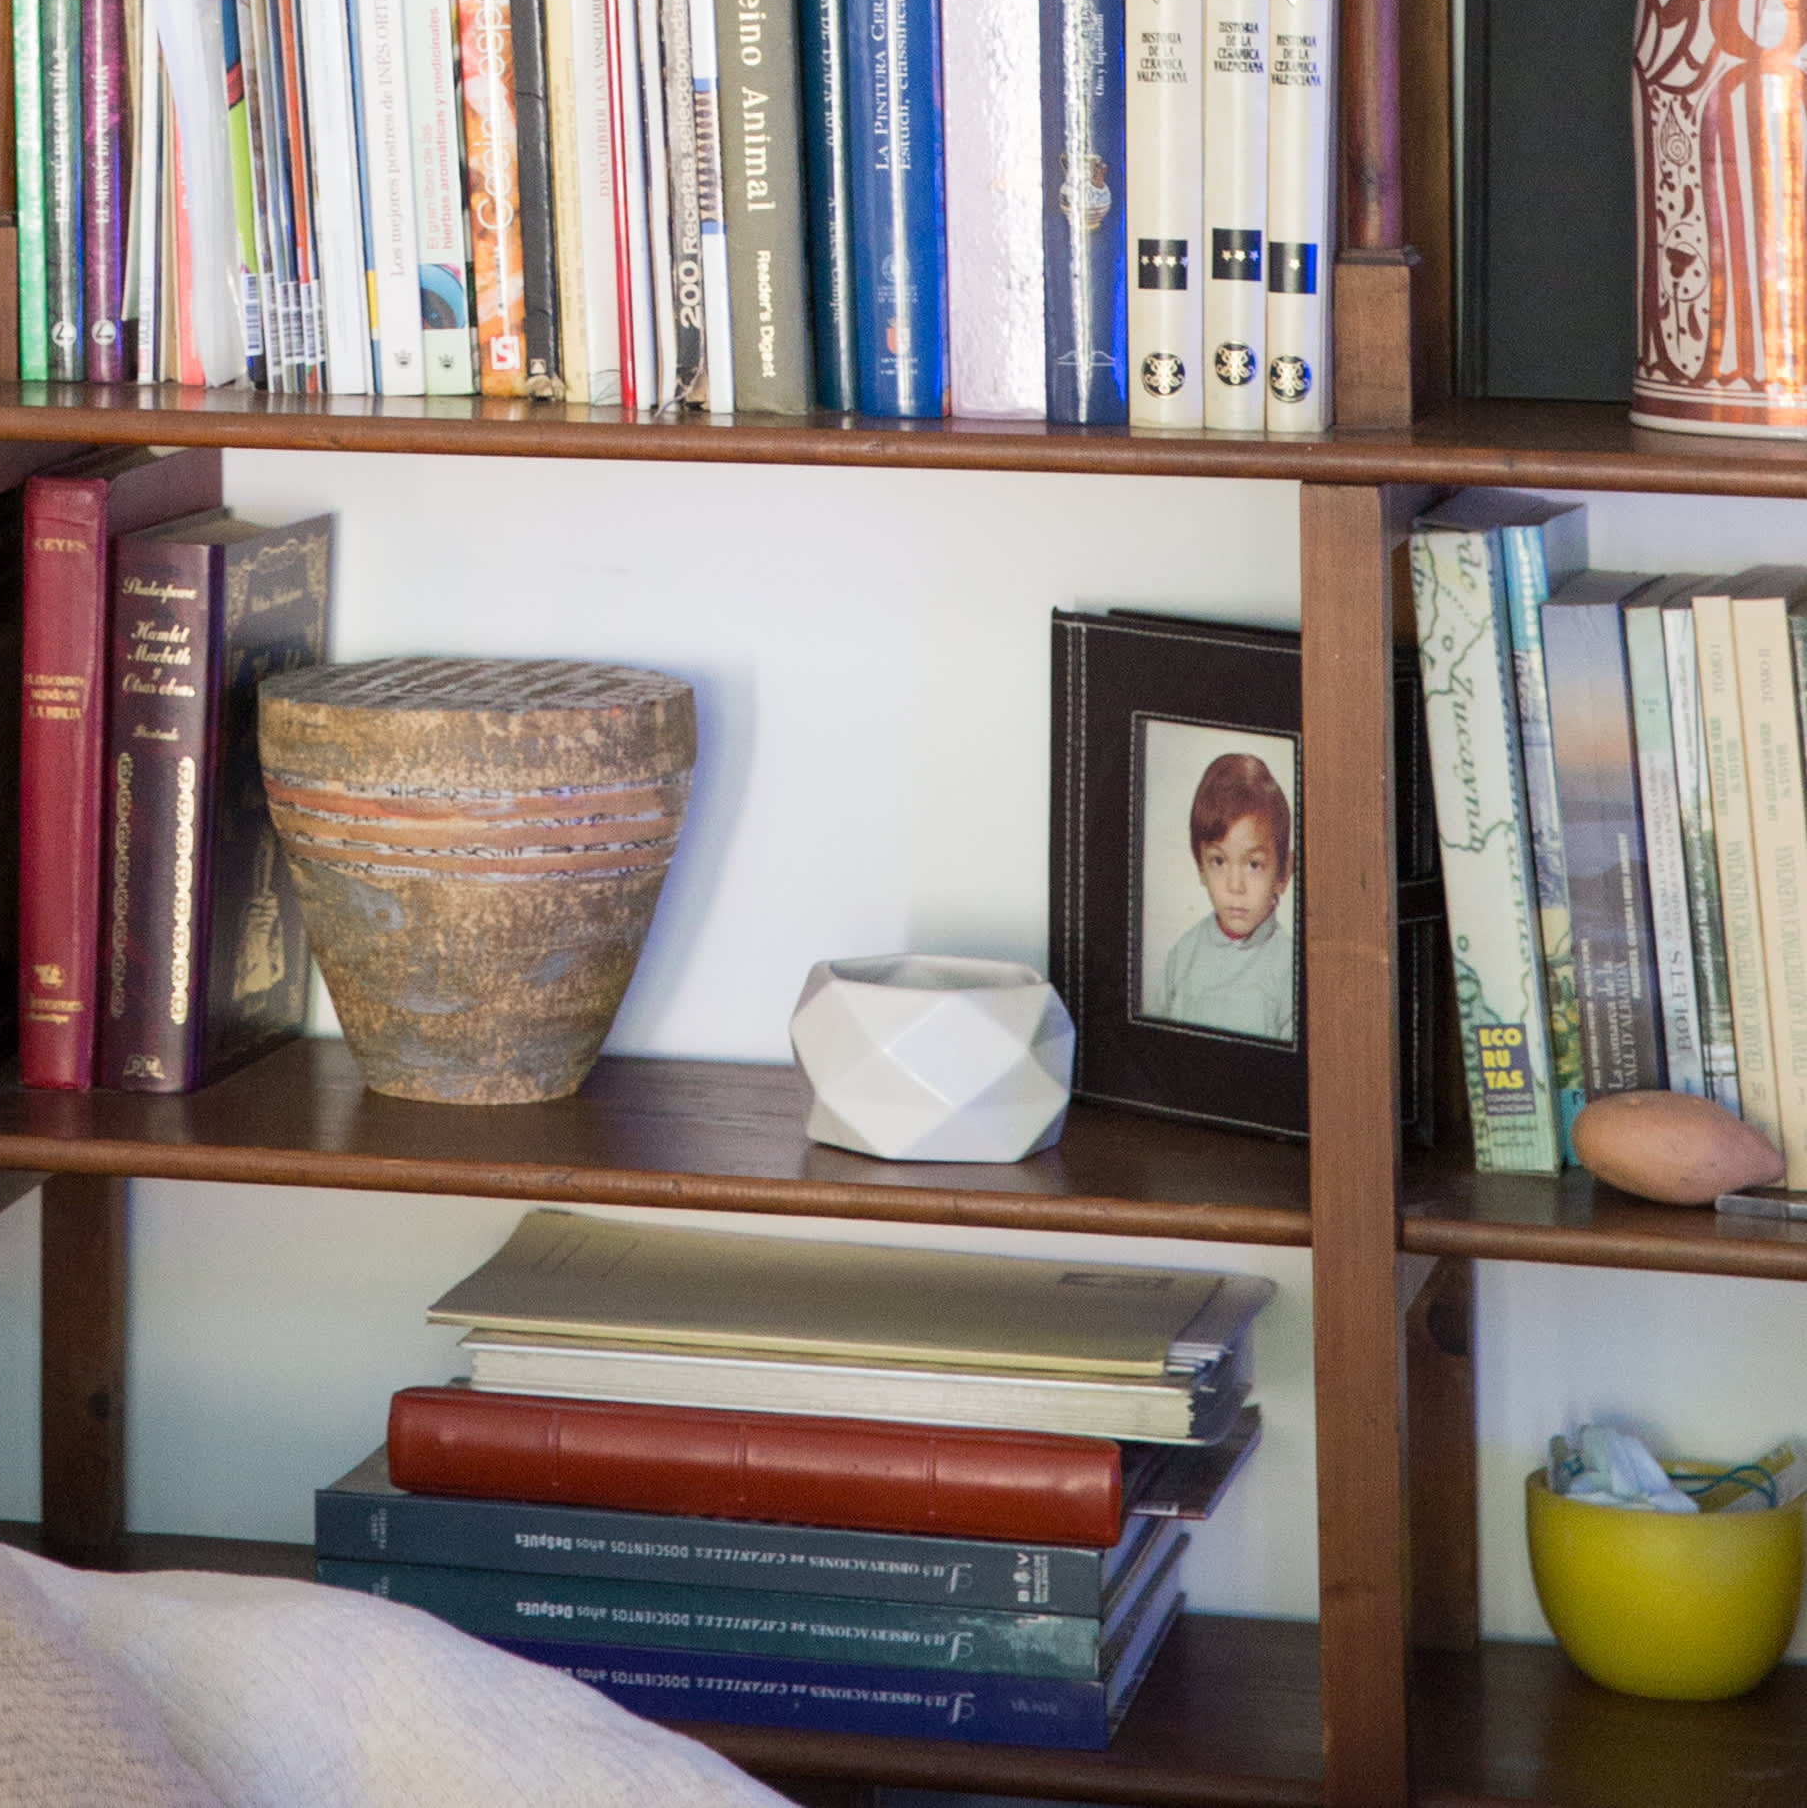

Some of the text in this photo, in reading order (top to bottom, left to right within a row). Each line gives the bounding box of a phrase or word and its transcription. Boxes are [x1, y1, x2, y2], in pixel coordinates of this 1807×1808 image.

[1141, 33, 1181, 45] HISTORIA
[1218, 22, 1259, 33] HISTORIA
[1226, 35, 1252, 47] DE LA
[427, 6, 445, 94] medicinales
[1148, 46, 1175, 57] DE LA
[1277, 36, 1317, 47] HISTORIA
[1283, 48, 1309, 60] DE LA
[90, 64, 109, 91] DÍA
[374, 44, 392, 86] INÉS
[1136, 71, 1188, 84] VALENCIANA
[1214, 61, 1265, 74] VALENCIANA
[593, 74, 607, 103] LAS
[873, 50, 889, 135] PINTURA
[1271, 75, 1321, 87] VALENCIANA
[379, 90, 393, 109] de
[95, 135, 109, 155] DE
[381, 111, 401, 174] postres
[432, 110, 452, 191] aromáticas
[594, 107, 610, 198] DESCUBRIR
[740, 86, 776, 212] Animal
[874, 145, 889, 170] LA
[91, 162, 110, 205] MENÚ
[421, 123, 440, 250] El gran libro de las
[97, 208, 110, 224] EL
[388, 176, 409, 243] mejores
[675, 156, 700, 254] Recetas
[439, 193, 456, 250] hierbas
[388, 247, 406, 277] Los
[677, 260, 703, 330] 200
[756, 249, 776, 378] Reader's Digest
[121, 575, 199, 604] Shakespeare
[131, 621, 191, 643] Hamlet
[126, 644, 193, 666] Macbeth
[153, 667, 163, 680] y
[1450, 675, 1486, 851] Zucayna
[1671, 950, 1694, 1051] BOLETS
[1479, 1028, 1523, 1048] ECO
[1481, 1050, 1512, 1069] RU
[1483, 1070, 1525, 1090] TAS
